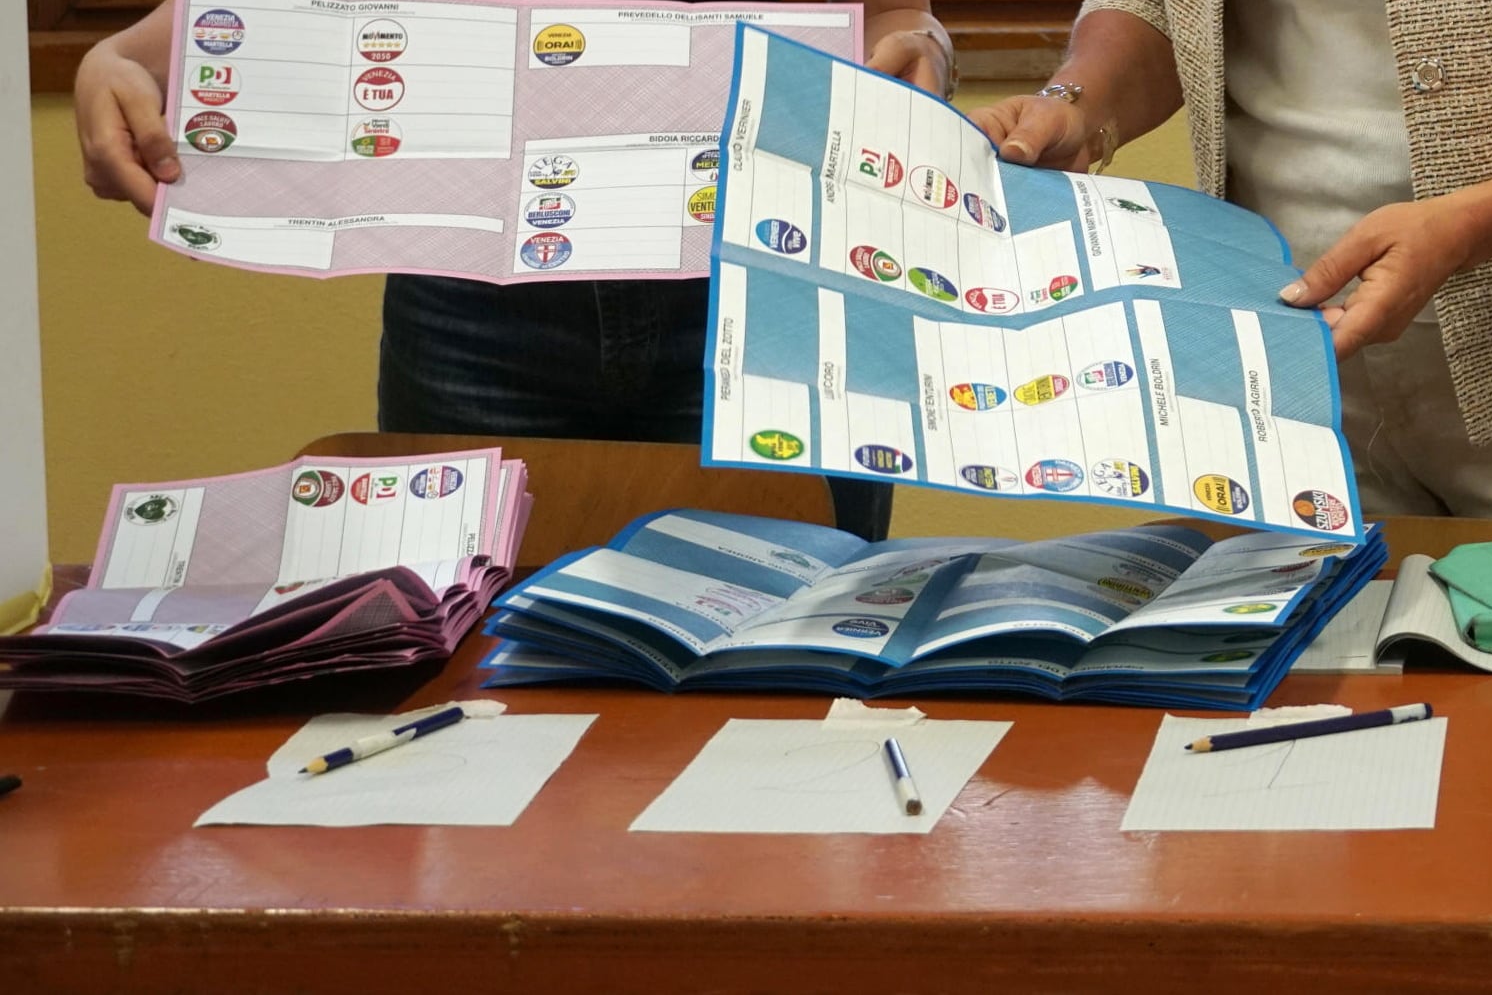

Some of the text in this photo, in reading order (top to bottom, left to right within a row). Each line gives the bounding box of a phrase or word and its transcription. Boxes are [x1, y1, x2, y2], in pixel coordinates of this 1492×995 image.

[311, 0, 356, 12] PELIZZATO
[206, 14, 235, 22] VENEZIA
[618, 11, 764, 21] PREVEDELLO DELLISANTI SAMUELE
[362, 30, 403, 41] MOVIMENTO
[544, 40, 574, 50] ORA!
[371, 52, 391, 60] 2050
[361, 70, 398, 81] VENEZIA
[371, 89, 394, 100] TUA
[735, 99, 751, 141] VERNIER
[649, 135, 720, 143] BIDOIA RICCARD
[826, 130, 841, 180] MARTELLA
[534, 155, 573, 169] LEGA
[923, 169, 934, 202] MOVIMENTO
[697, 192, 716, 201] SIM
[528, 210, 571, 218] BERLUSCONI
[287, 218, 326, 226] TRENTIN
[327, 216, 386, 227] ALESSANDRA
[530, 236, 565, 244] VENEZIA
[1149, 358, 1169, 427] MICHELE BOLDRIN
[1248, 369, 1267, 443] ROBERTO AGIRMO
[1093, 462, 1114, 493] LEGA
[1129, 465, 1142, 494] SALVINI
[1216, 482, 1227, 506] ORA!
[1312, 490, 1329, 529] SZUMSKI
[833, 626, 882, 636] VERNIER
